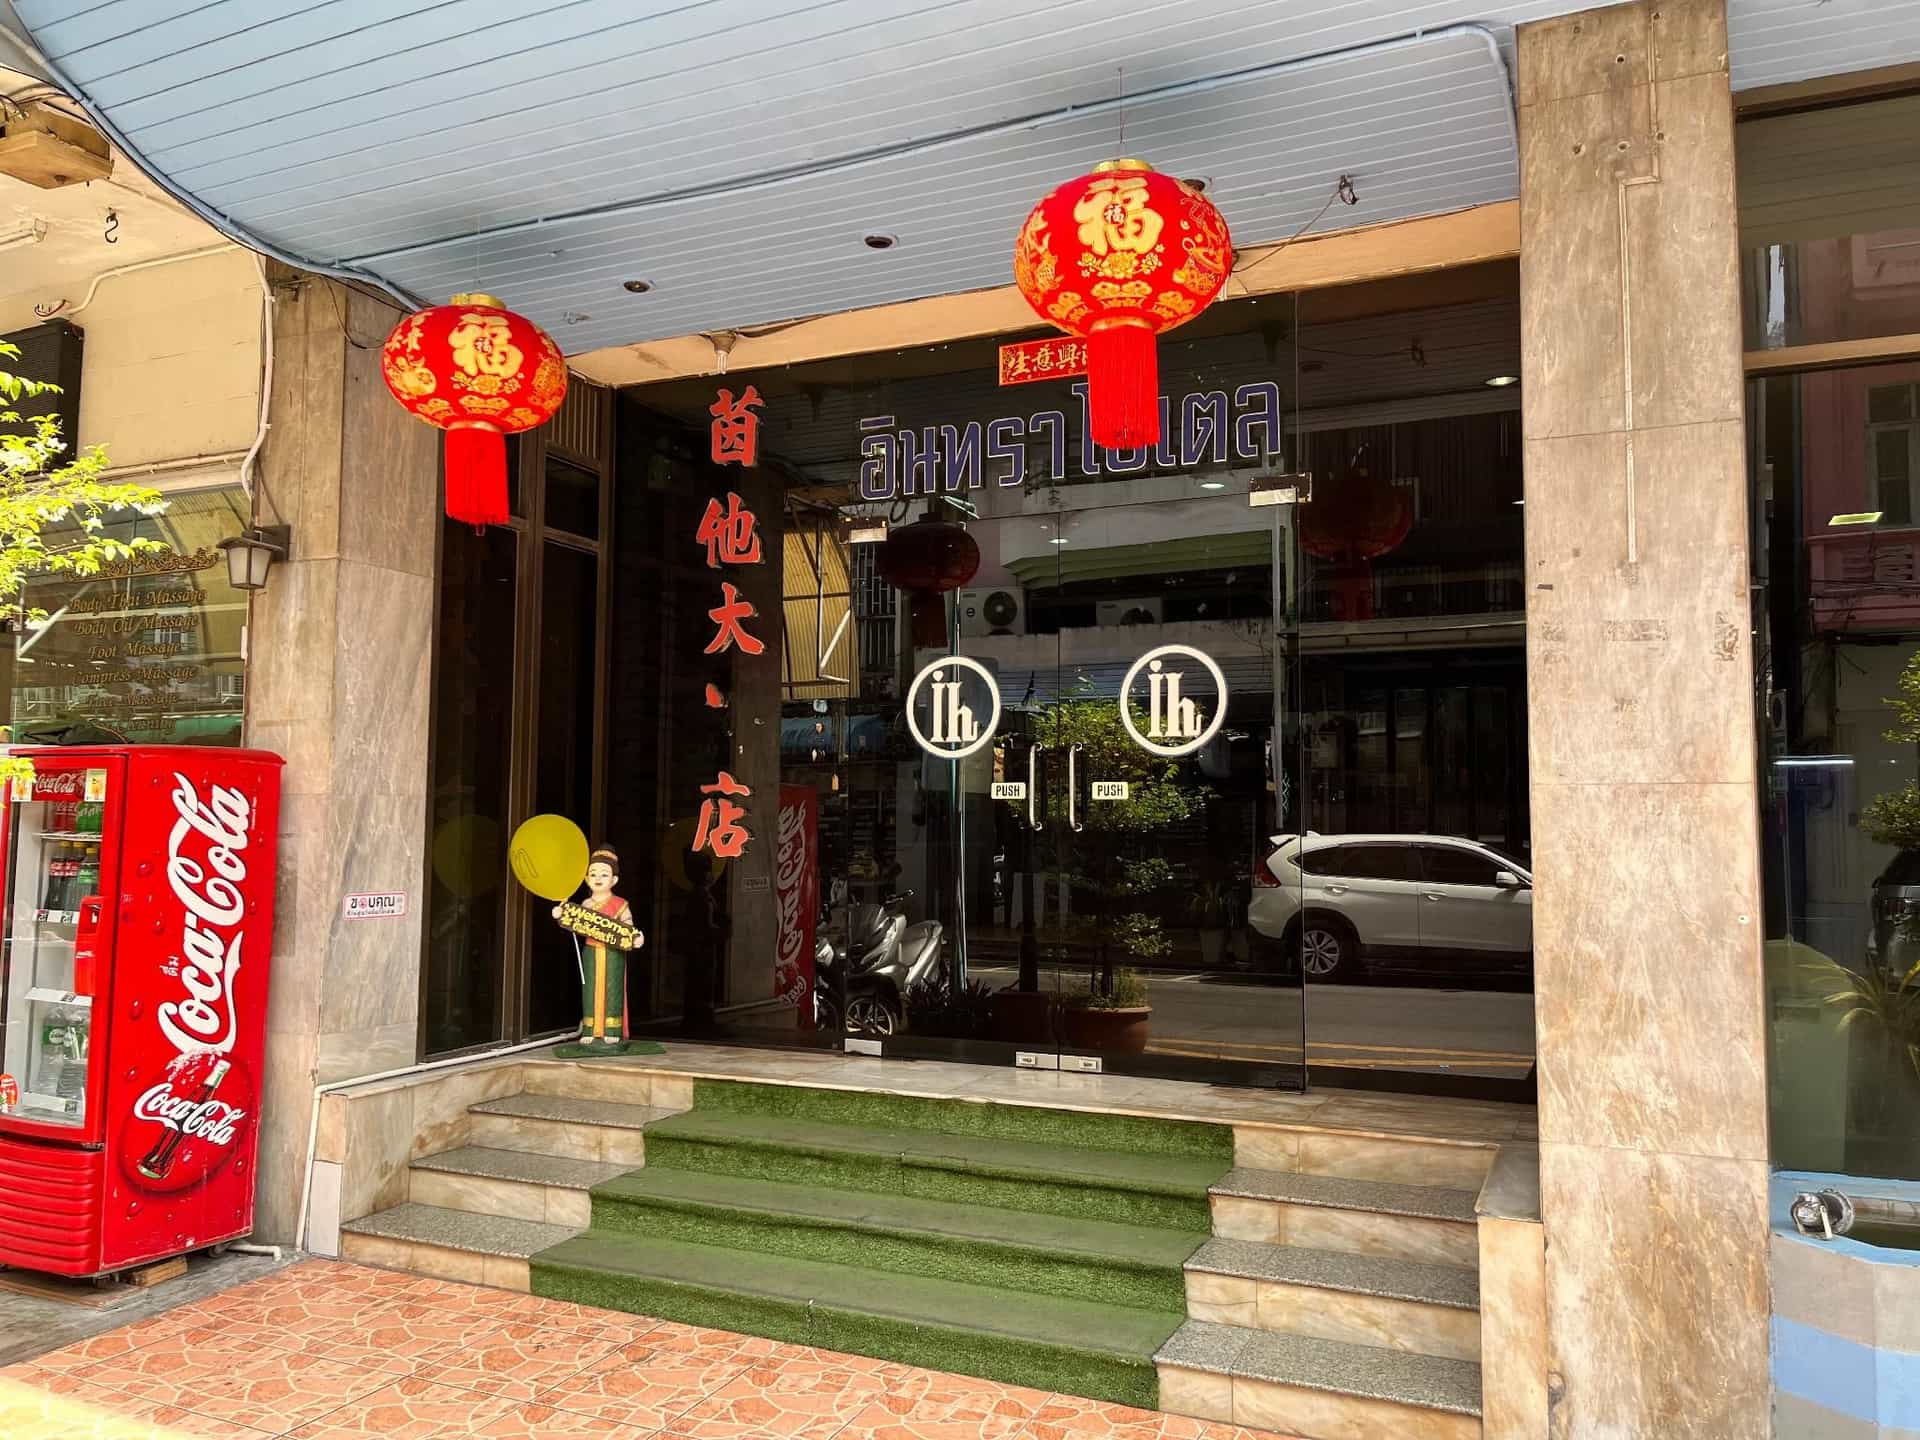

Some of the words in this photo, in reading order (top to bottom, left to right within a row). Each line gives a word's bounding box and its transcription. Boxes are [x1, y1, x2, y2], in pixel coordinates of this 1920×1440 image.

[1074, 178, 1164, 256] 福
[448, 313, 524, 378] 福
[1008, 343, 1088, 376] 生意興
[860, 382, 1281, 501] อินทราโเตล
[691, 384, 766, 858] 茵他大店
[995, 784, 1021, 798] PUSH
[1096, 783, 1124, 797] PUSH
[158, 771, 251, 1054] Coca-Cola
[568, 904, 630, 937] Welcome
[134, 1083, 247, 1145] Coca-Cola
